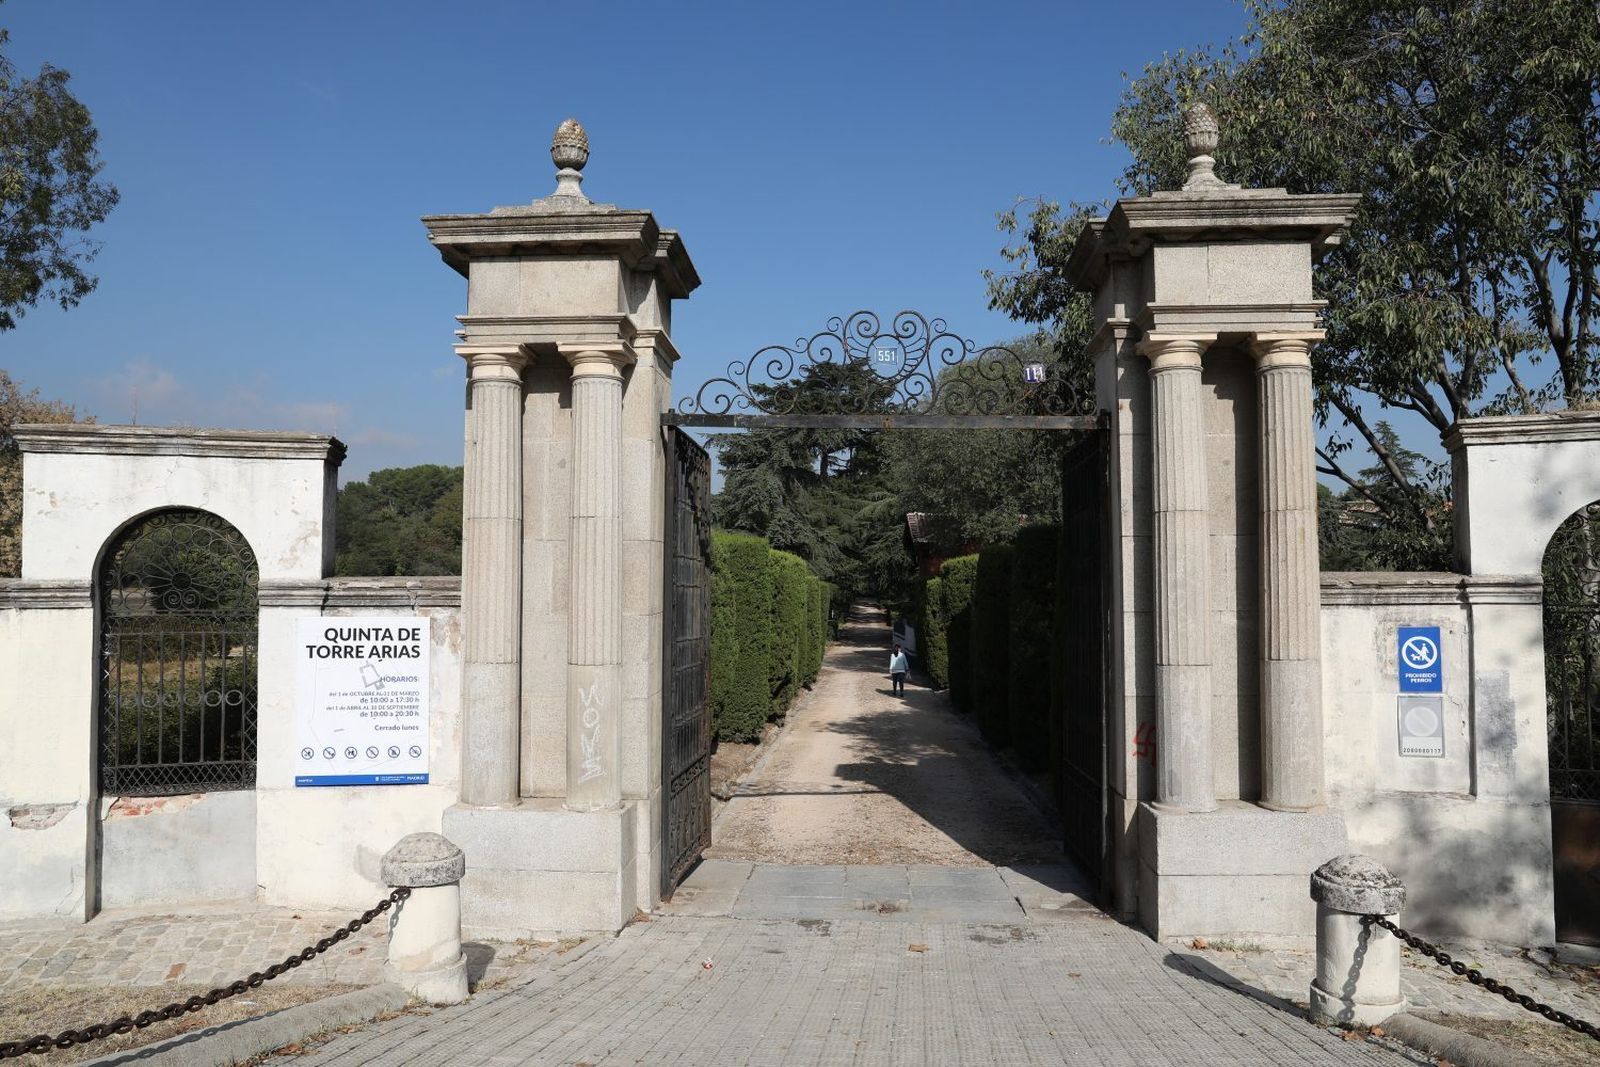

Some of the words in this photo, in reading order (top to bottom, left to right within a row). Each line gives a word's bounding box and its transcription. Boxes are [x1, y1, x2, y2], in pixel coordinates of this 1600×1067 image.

[878, 350, 895, 361] 551
[324, 627, 394, 644] QUINTA
[398, 627, 421, 641] DE
[306, 645, 365, 659] TORRE
[368, 645, 421, 659] ARIAS
